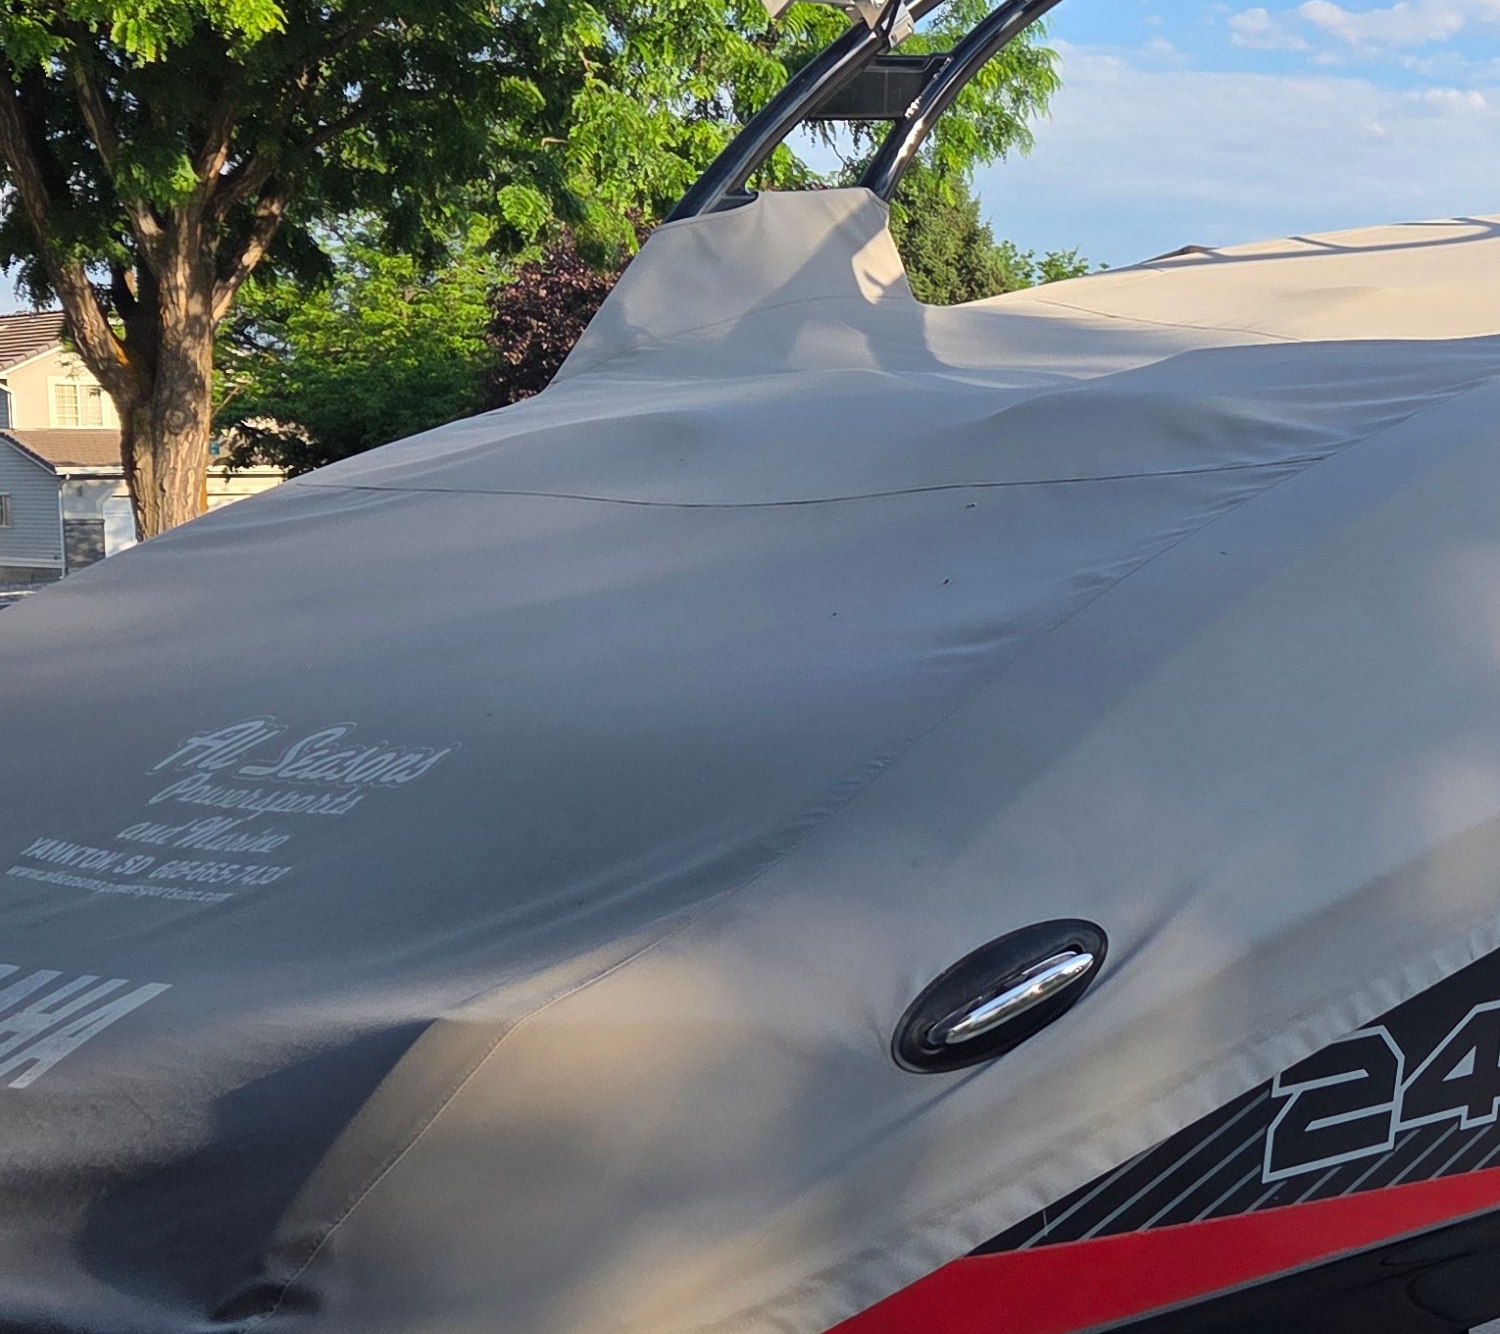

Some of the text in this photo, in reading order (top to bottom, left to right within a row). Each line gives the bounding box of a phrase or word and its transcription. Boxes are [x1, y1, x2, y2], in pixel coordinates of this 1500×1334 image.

[150, 718, 456, 786] All Seasons
[148, 772, 365, 819] Powersports
[116, 816, 291, 853] and Marine
[113, 854, 156, 875] SD
[0, 963, 174, 1090] HA
